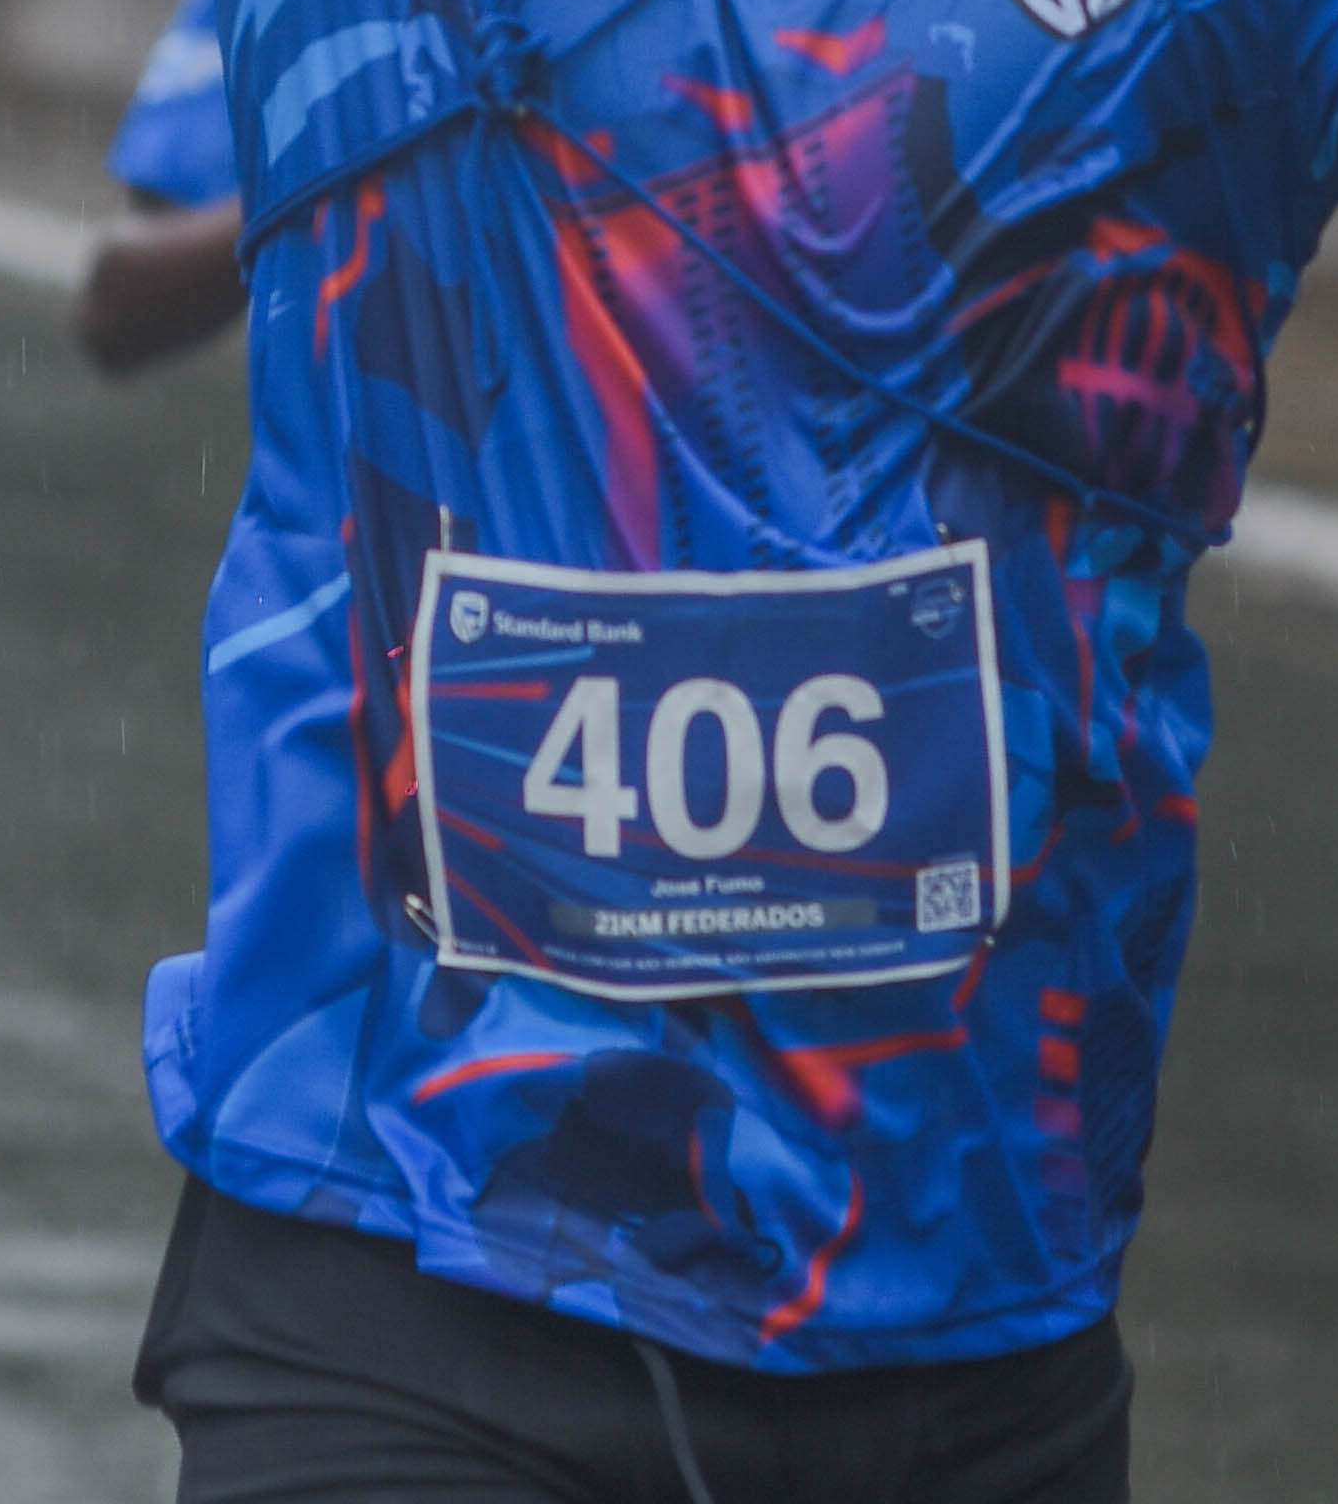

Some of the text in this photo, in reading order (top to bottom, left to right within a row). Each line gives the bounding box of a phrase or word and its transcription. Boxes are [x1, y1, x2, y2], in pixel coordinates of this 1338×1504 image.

[493, 610, 643, 642] Standard Bank
[522, 674, 889, 860] 406
[595, 903, 824, 936] 21KM FEDERADOS
